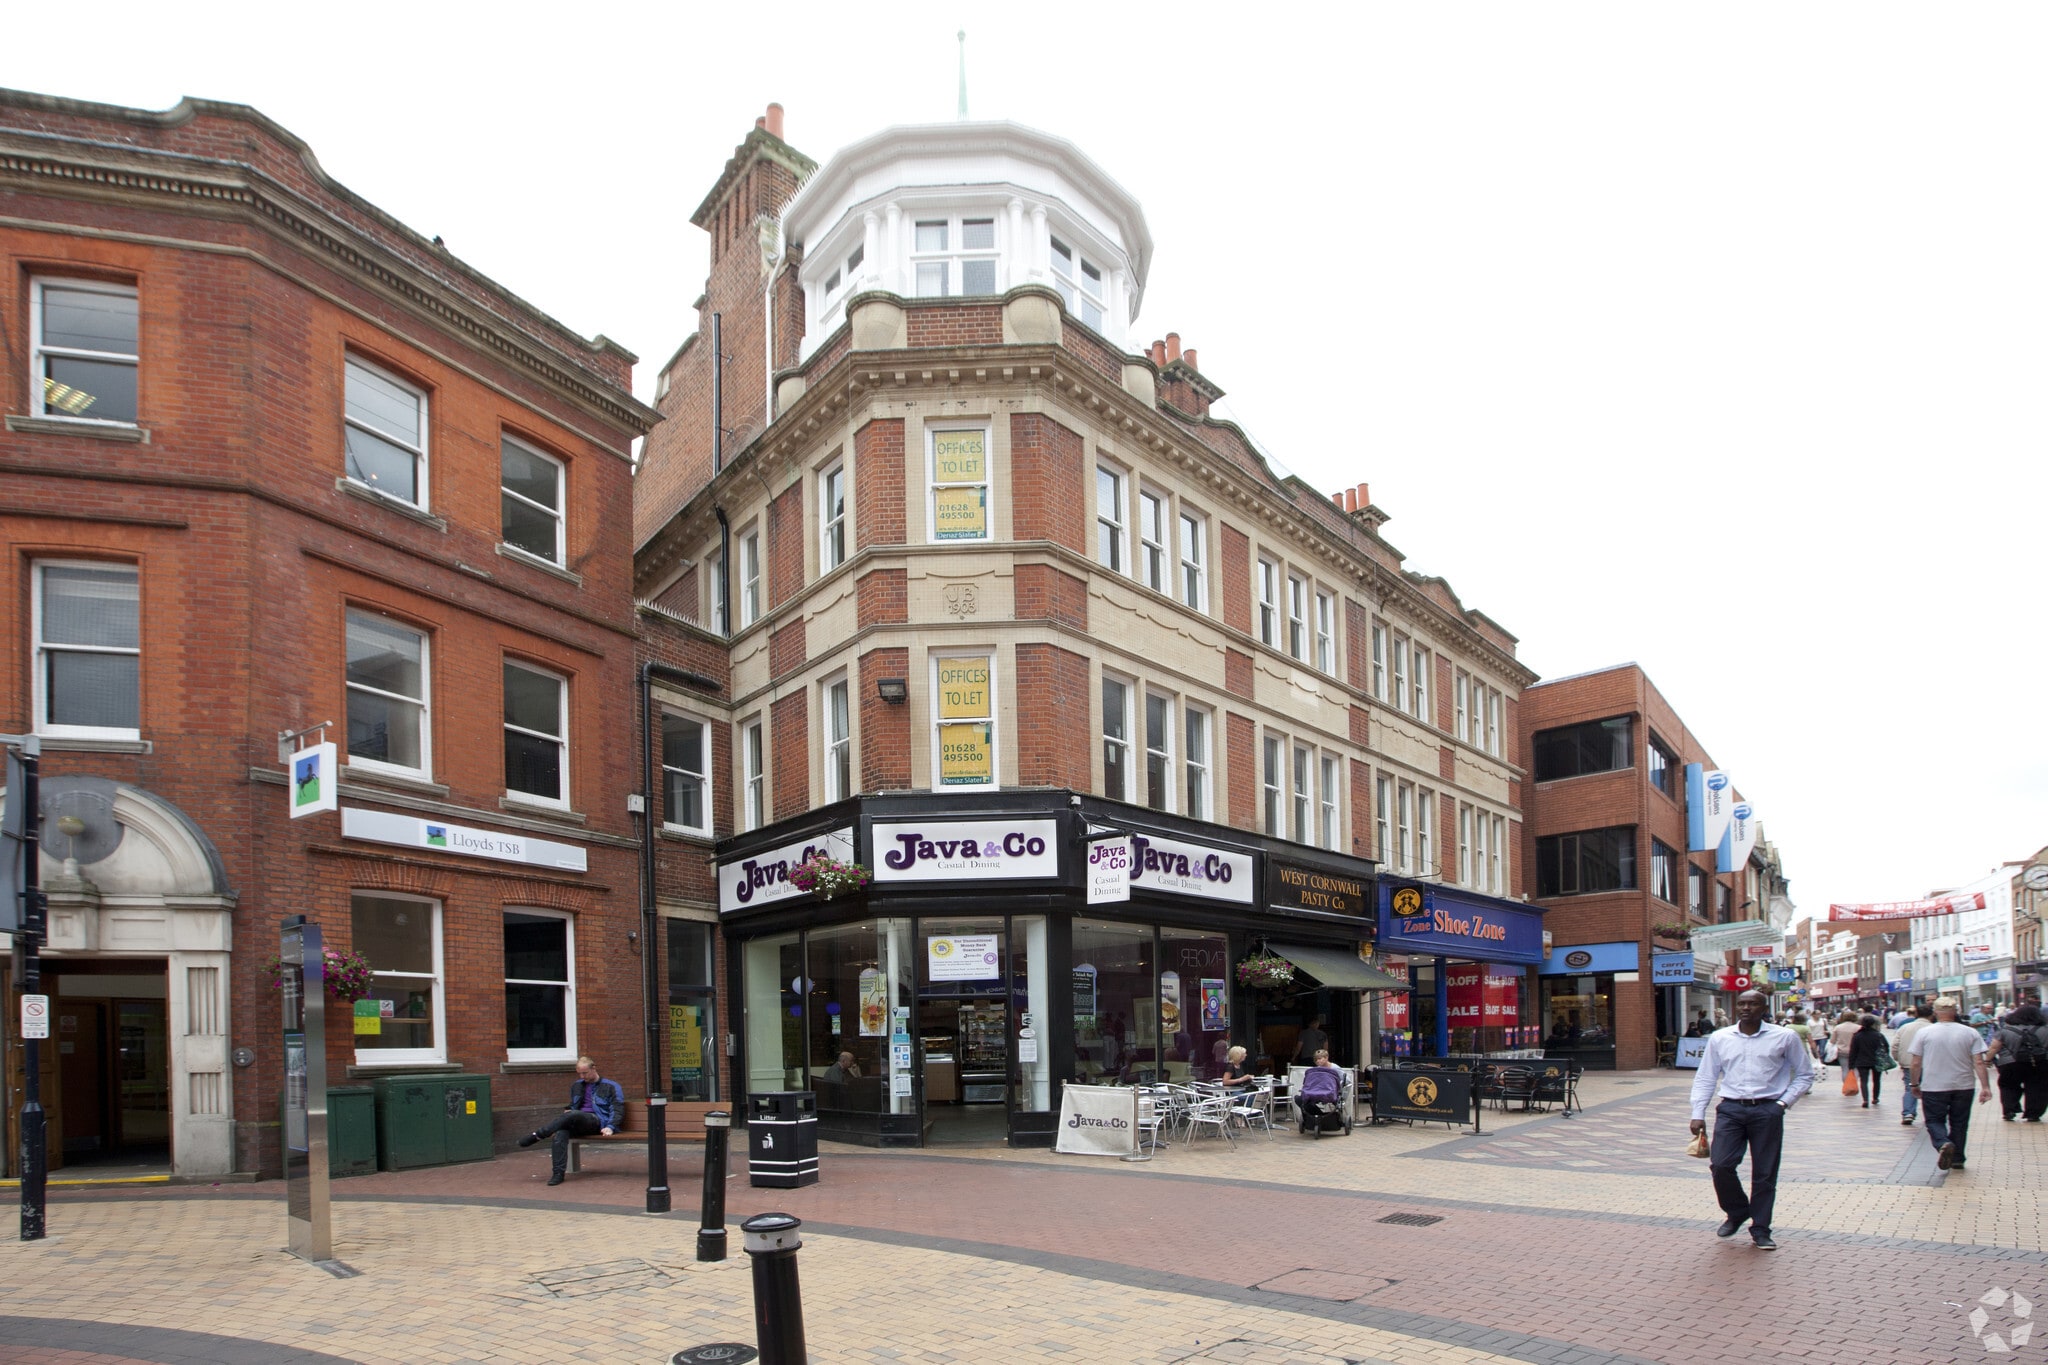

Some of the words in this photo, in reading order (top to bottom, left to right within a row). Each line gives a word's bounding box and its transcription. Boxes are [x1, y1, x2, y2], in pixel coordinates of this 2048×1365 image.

[937, 441, 983, 455] OFFICES
[941, 461, 957, 473] TO
[960, 460, 978, 473] LET
[939, 503, 968, 512] 01628
[940, 511, 974, 520] 495500
[941, 669, 987, 684] OFFICES
[945, 691, 961, 706] TO
[963, 691, 983, 705] LET
[943, 744, 976, 753] 01628
[943, 753, 983, 762] 495500
[452, 833, 494, 852] Lloyds
[497, 840, 520, 855] TSB
[1089, 845, 1127, 864] Java
[937, 861, 966, 869] Casual
[970, 859, 1001, 869] Dining
[1095, 874, 1120, 885] Casual
[1157, 875, 1179, 887] Casual
[1181, 879, 1202, 891] Dining
[1280, 869, 1308, 886] WEST
[1310, 875, 1362, 896] CORNWALL
[765, 888, 782, 898] Casual
[1094, 886, 1121, 896] Dining
[1301, 890, 1330, 907] PASTY
[1403, 920, 1431, 933] Zone
[1434, 909, 1470, 936] Shoe
[1472, 915, 1506, 941] Zone
[1655, 968, 1691, 977] NERO
[1484, 975, 1500, 985] SALE
[670, 1007, 683, 1017] TO
[1502, 1005, 1517, 1015] SALE
[670, 1019, 687, 1029] LET
[1685, 1050, 1706, 1058] NE
